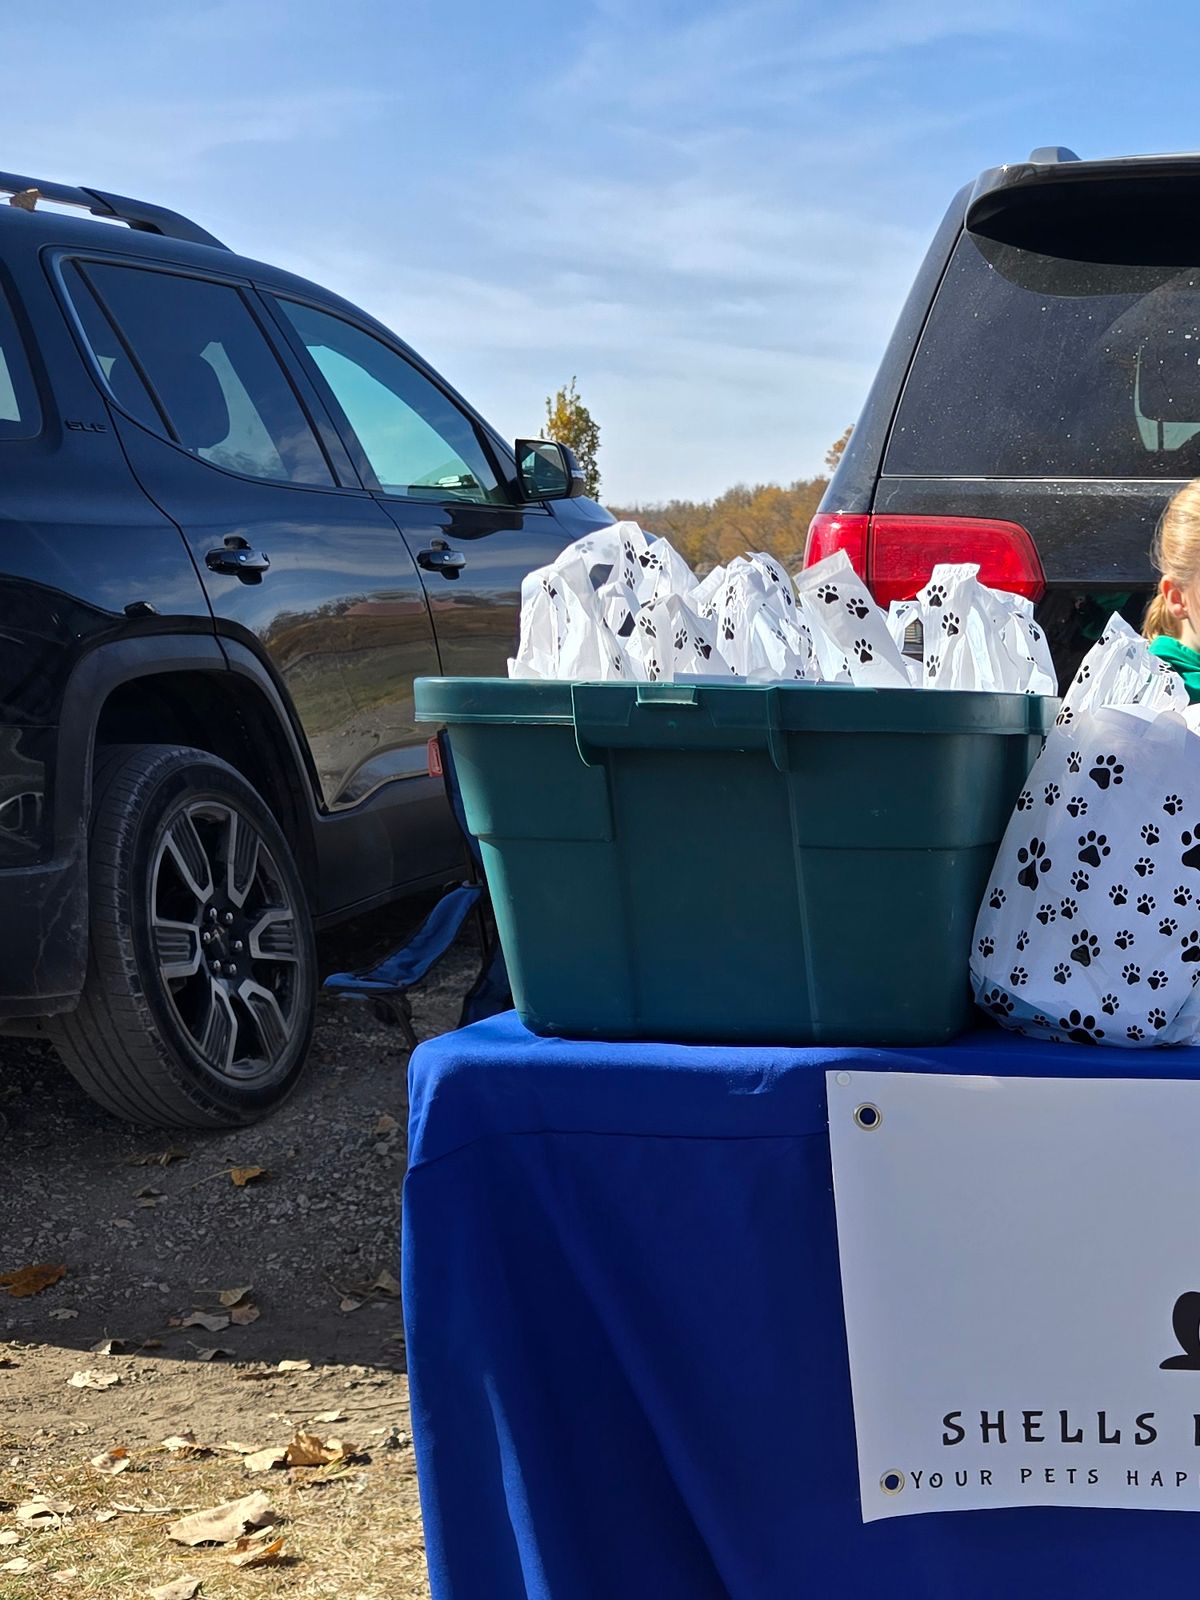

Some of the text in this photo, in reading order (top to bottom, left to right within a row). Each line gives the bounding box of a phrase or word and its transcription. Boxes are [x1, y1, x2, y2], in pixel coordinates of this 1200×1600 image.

[942, 1409, 1158, 1446] SHELLS
[910, 1469, 993, 1490] YOUR
[1020, 1468, 1099, 1485] PETS
